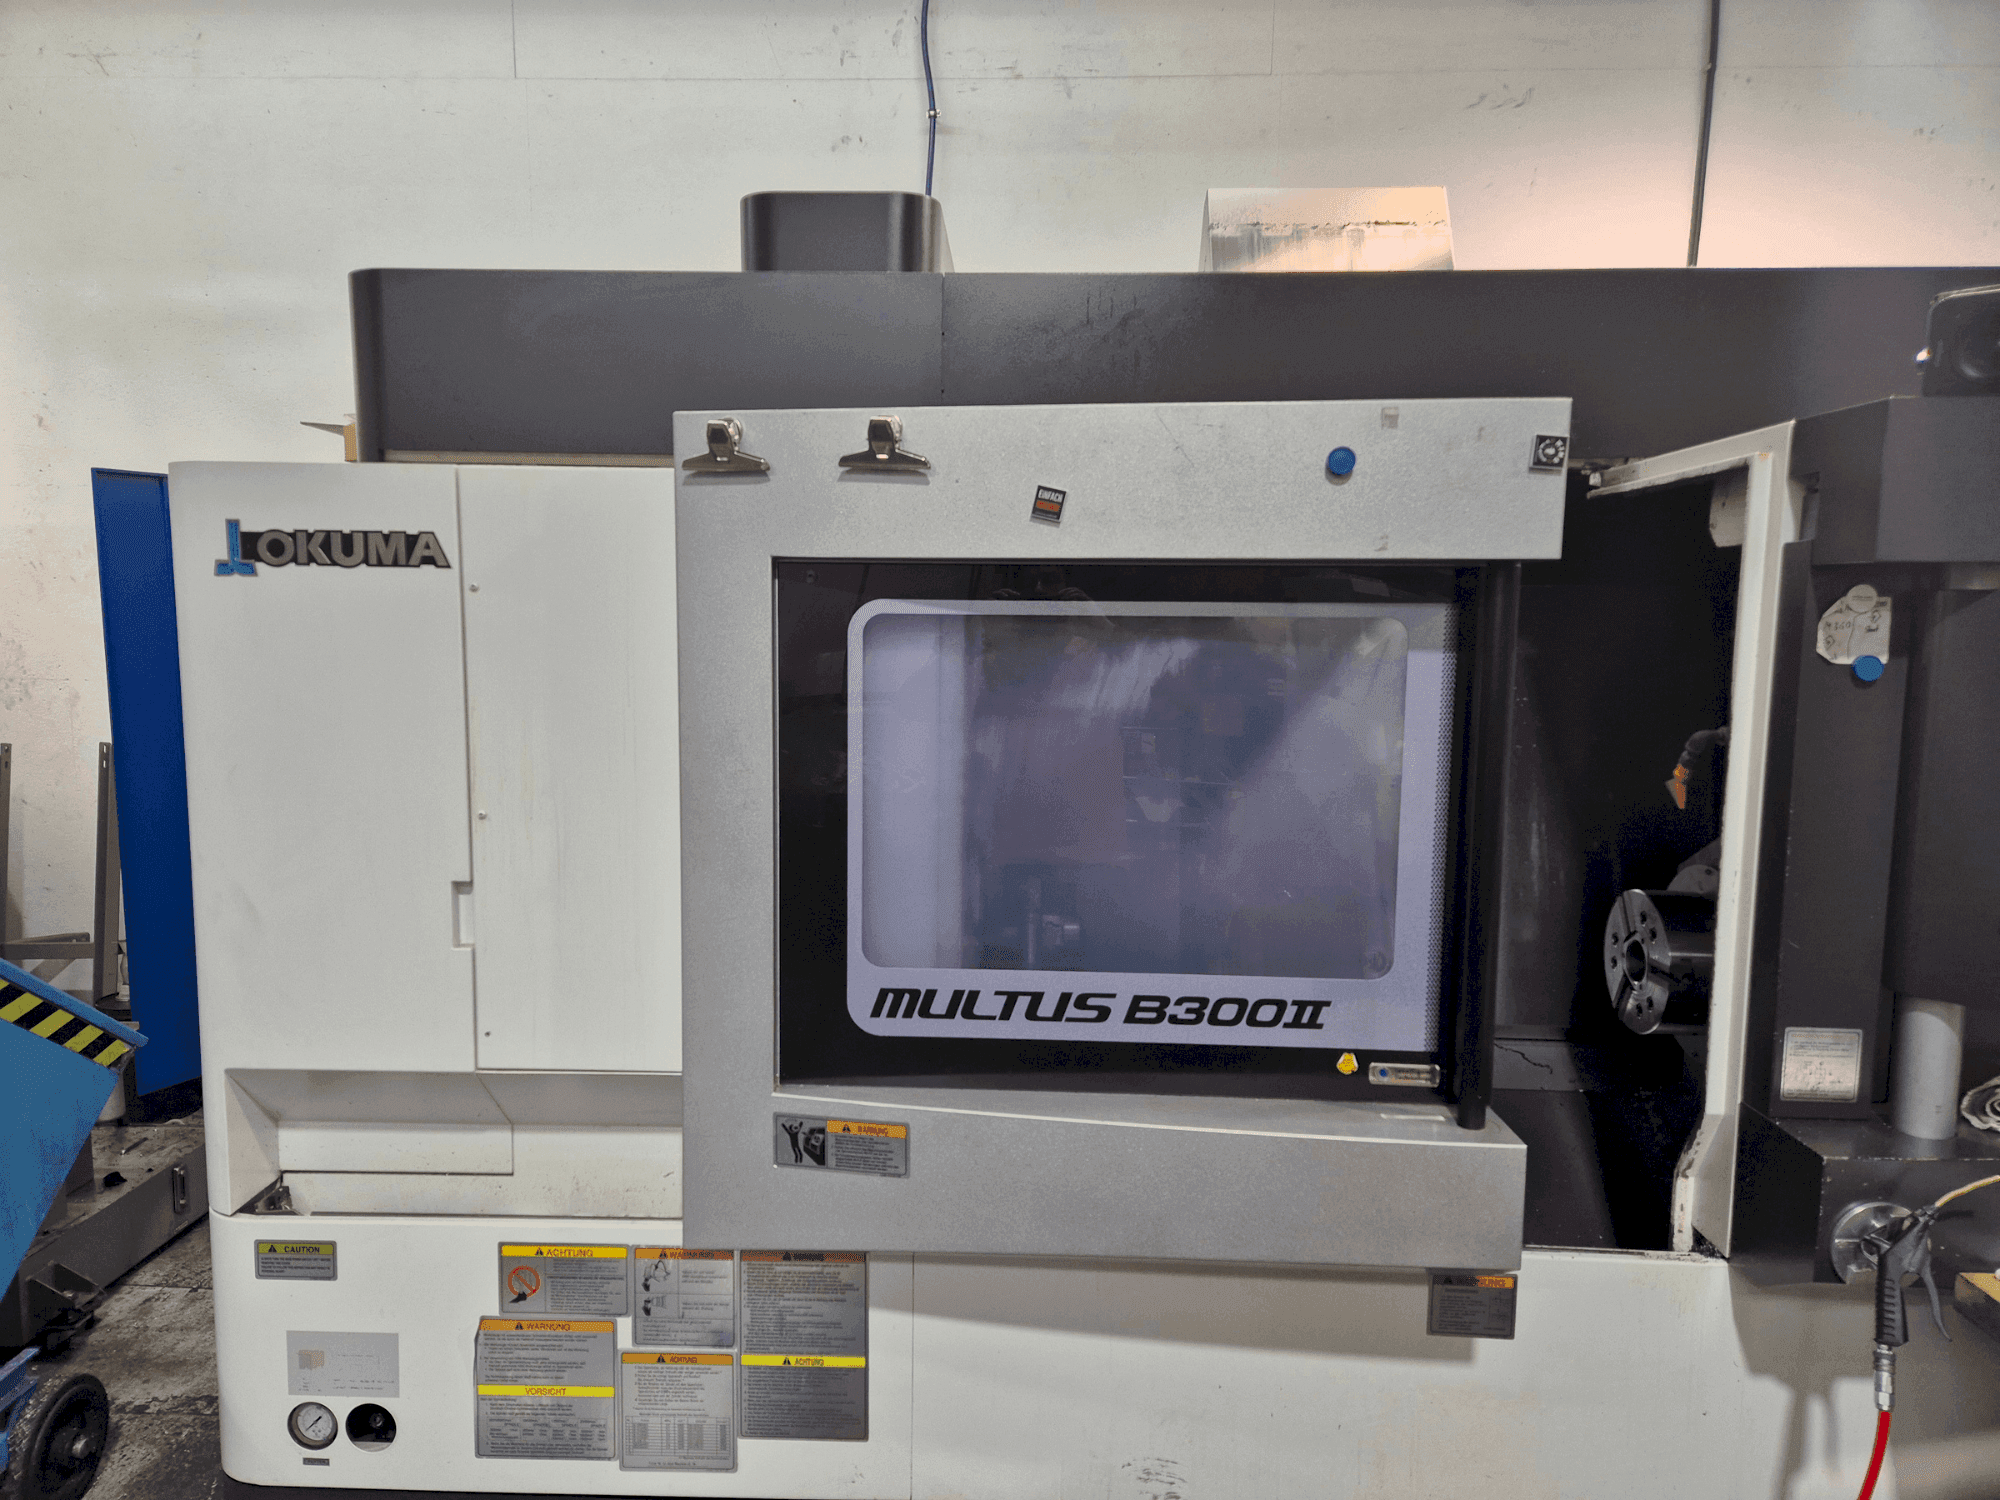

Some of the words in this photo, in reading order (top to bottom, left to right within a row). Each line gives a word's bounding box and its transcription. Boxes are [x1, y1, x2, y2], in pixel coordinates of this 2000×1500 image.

[256, 529, 452, 568] OKUMA
[870, 987, 1118, 1024] MULTUS
[284, 1245, 320, 1254] CAUTION
[546, 1248, 594, 1258] ACHTUNG
[526, 1322, 571, 1332] WARNUNG
[669, 1355, 698, 1364] ACHTUNG
[794, 1357, 825, 1367] ACHTUNG
[525, 1387, 567, 1397] VORSICHT
